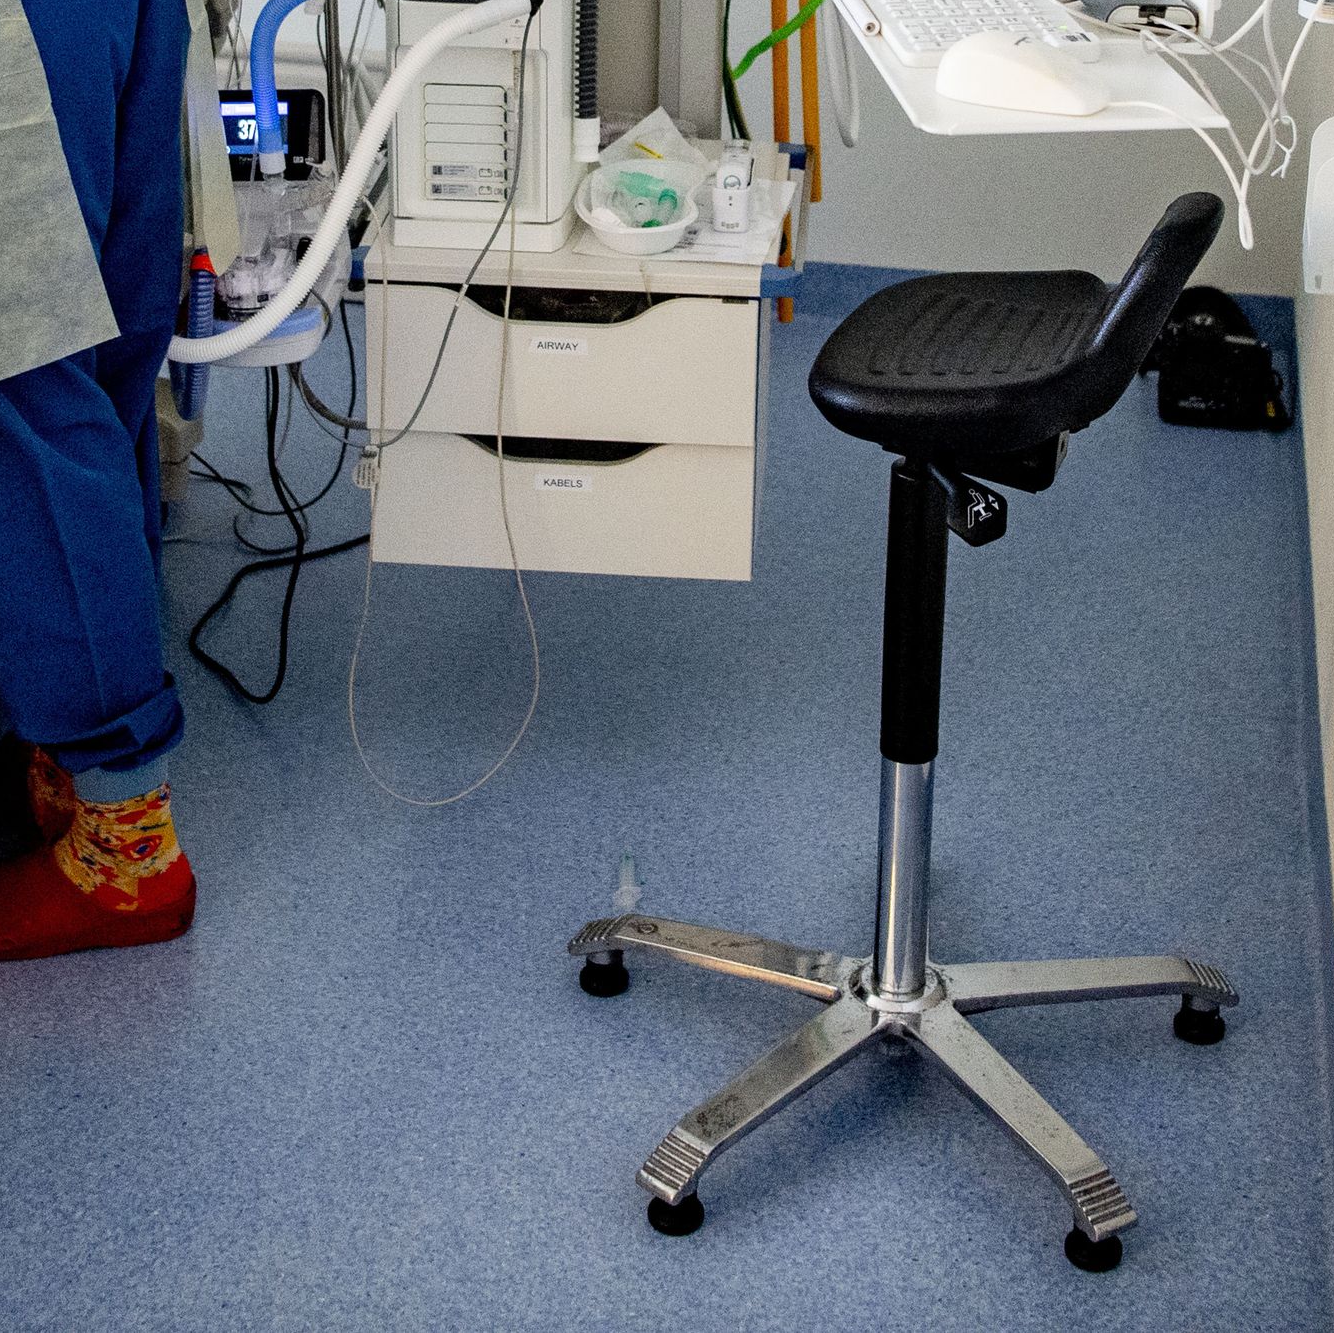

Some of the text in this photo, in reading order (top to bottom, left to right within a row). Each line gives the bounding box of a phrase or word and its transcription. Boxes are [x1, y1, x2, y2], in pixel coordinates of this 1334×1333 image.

[238, 119, 257, 140] 37
[537, 341, 578, 351] AIRWAY
[543, 478, 583, 489] KABELS
